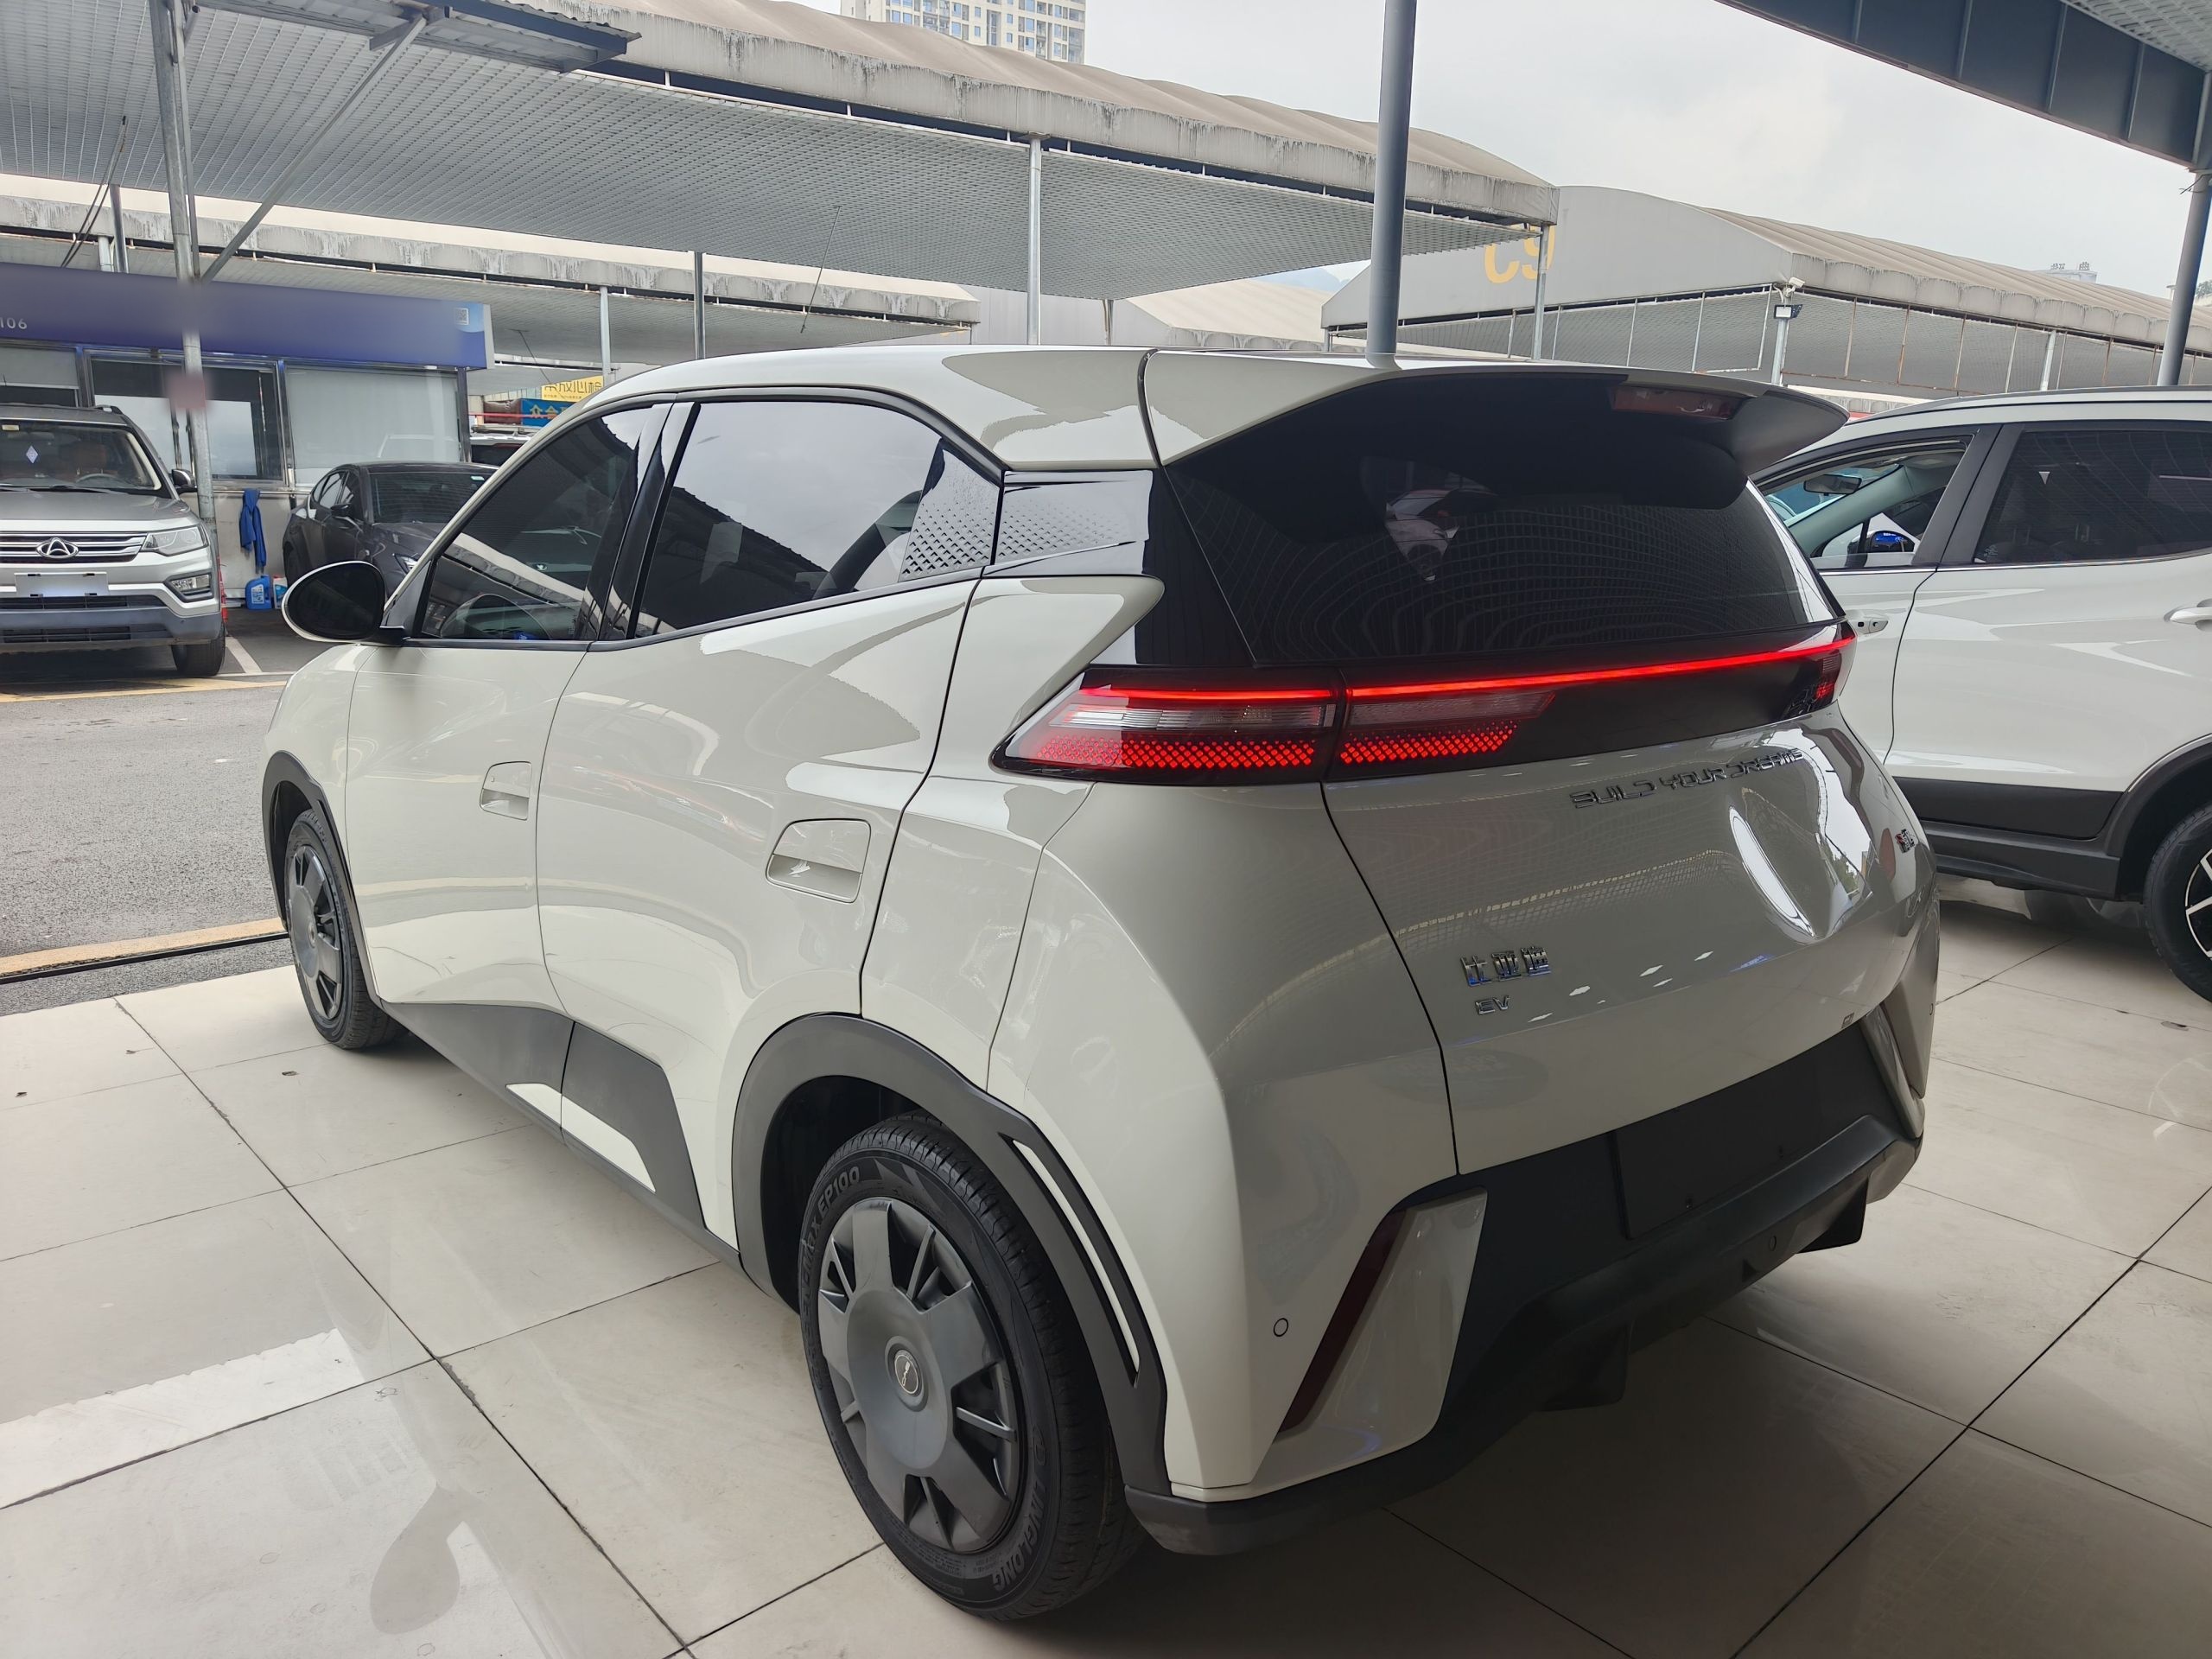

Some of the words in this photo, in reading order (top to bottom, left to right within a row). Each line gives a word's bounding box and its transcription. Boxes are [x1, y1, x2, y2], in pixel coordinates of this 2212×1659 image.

[1569, 779, 1657, 809] BUILD
[1660, 766, 1727, 790] YOUR
[1726, 747, 1804, 778] DREAMS
[1459, 946, 1552, 987] 比亚迪
[1475, 995, 1510, 1014] EV
[817, 1166, 860, 1211] EP100
[992, 1478, 1047, 1592] LINGLONG
